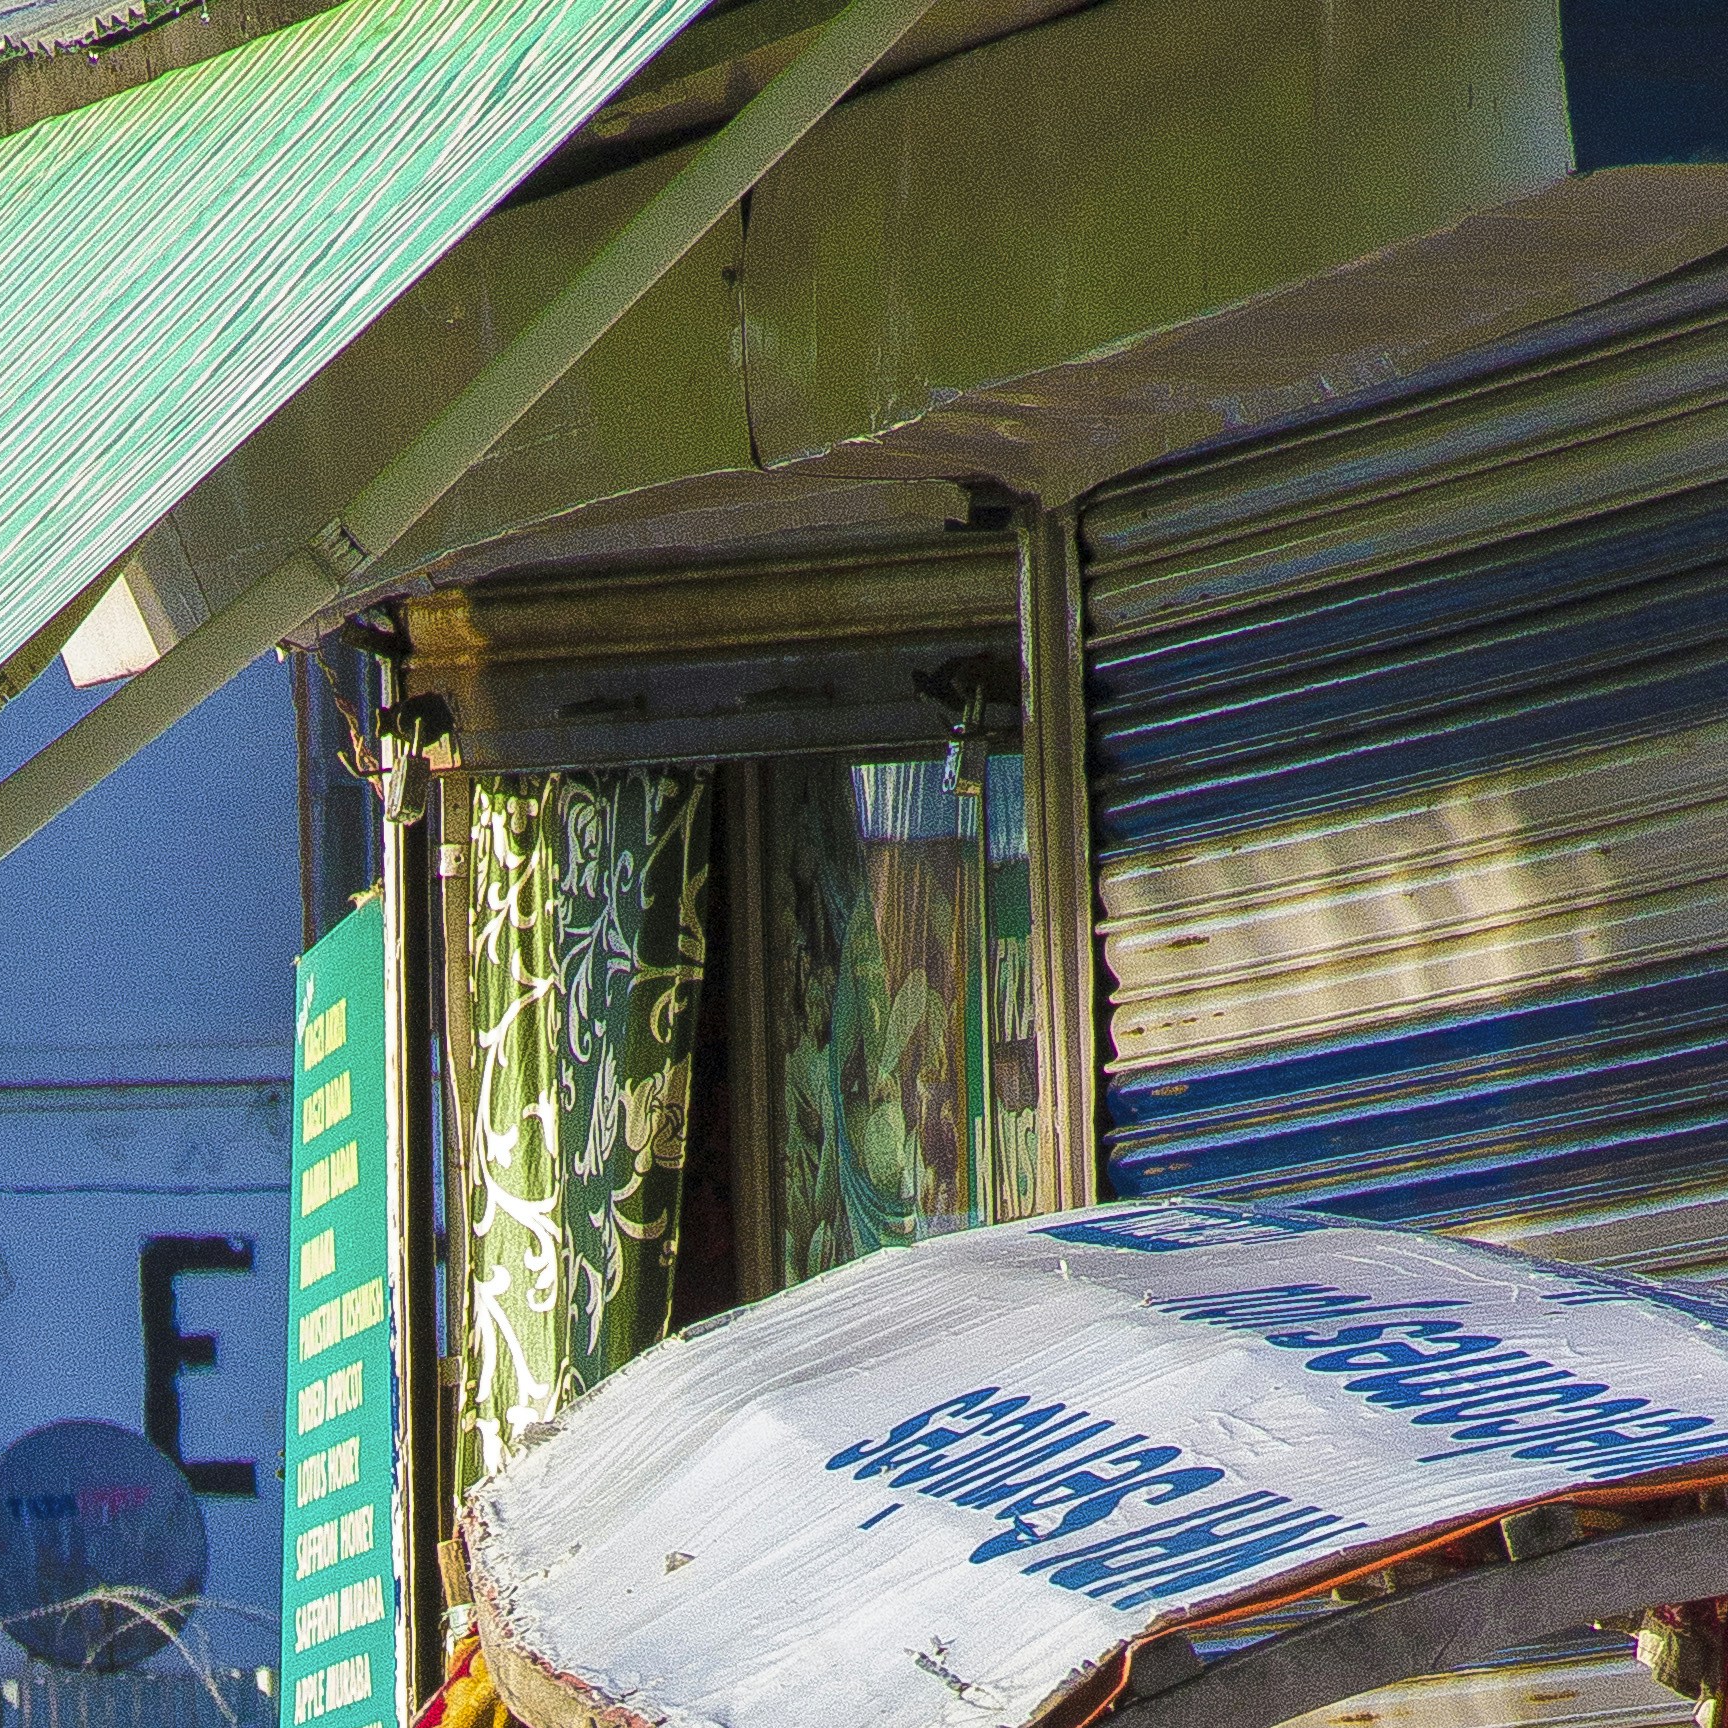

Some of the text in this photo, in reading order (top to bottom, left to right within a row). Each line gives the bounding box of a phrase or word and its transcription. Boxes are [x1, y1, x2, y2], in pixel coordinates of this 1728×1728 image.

[299, 1361, 362, 1435] DRIED APRICOT
[298, 1437, 359, 1507] LOTUS HONEY
[825, 1387, 1368, 1611] NRI Services
[297, 1505, 373, 1580] SAFFRON HONEY
[296, 1592, 339, 1653] SAFFRON
[295, 1670, 324, 1725] APPLE
